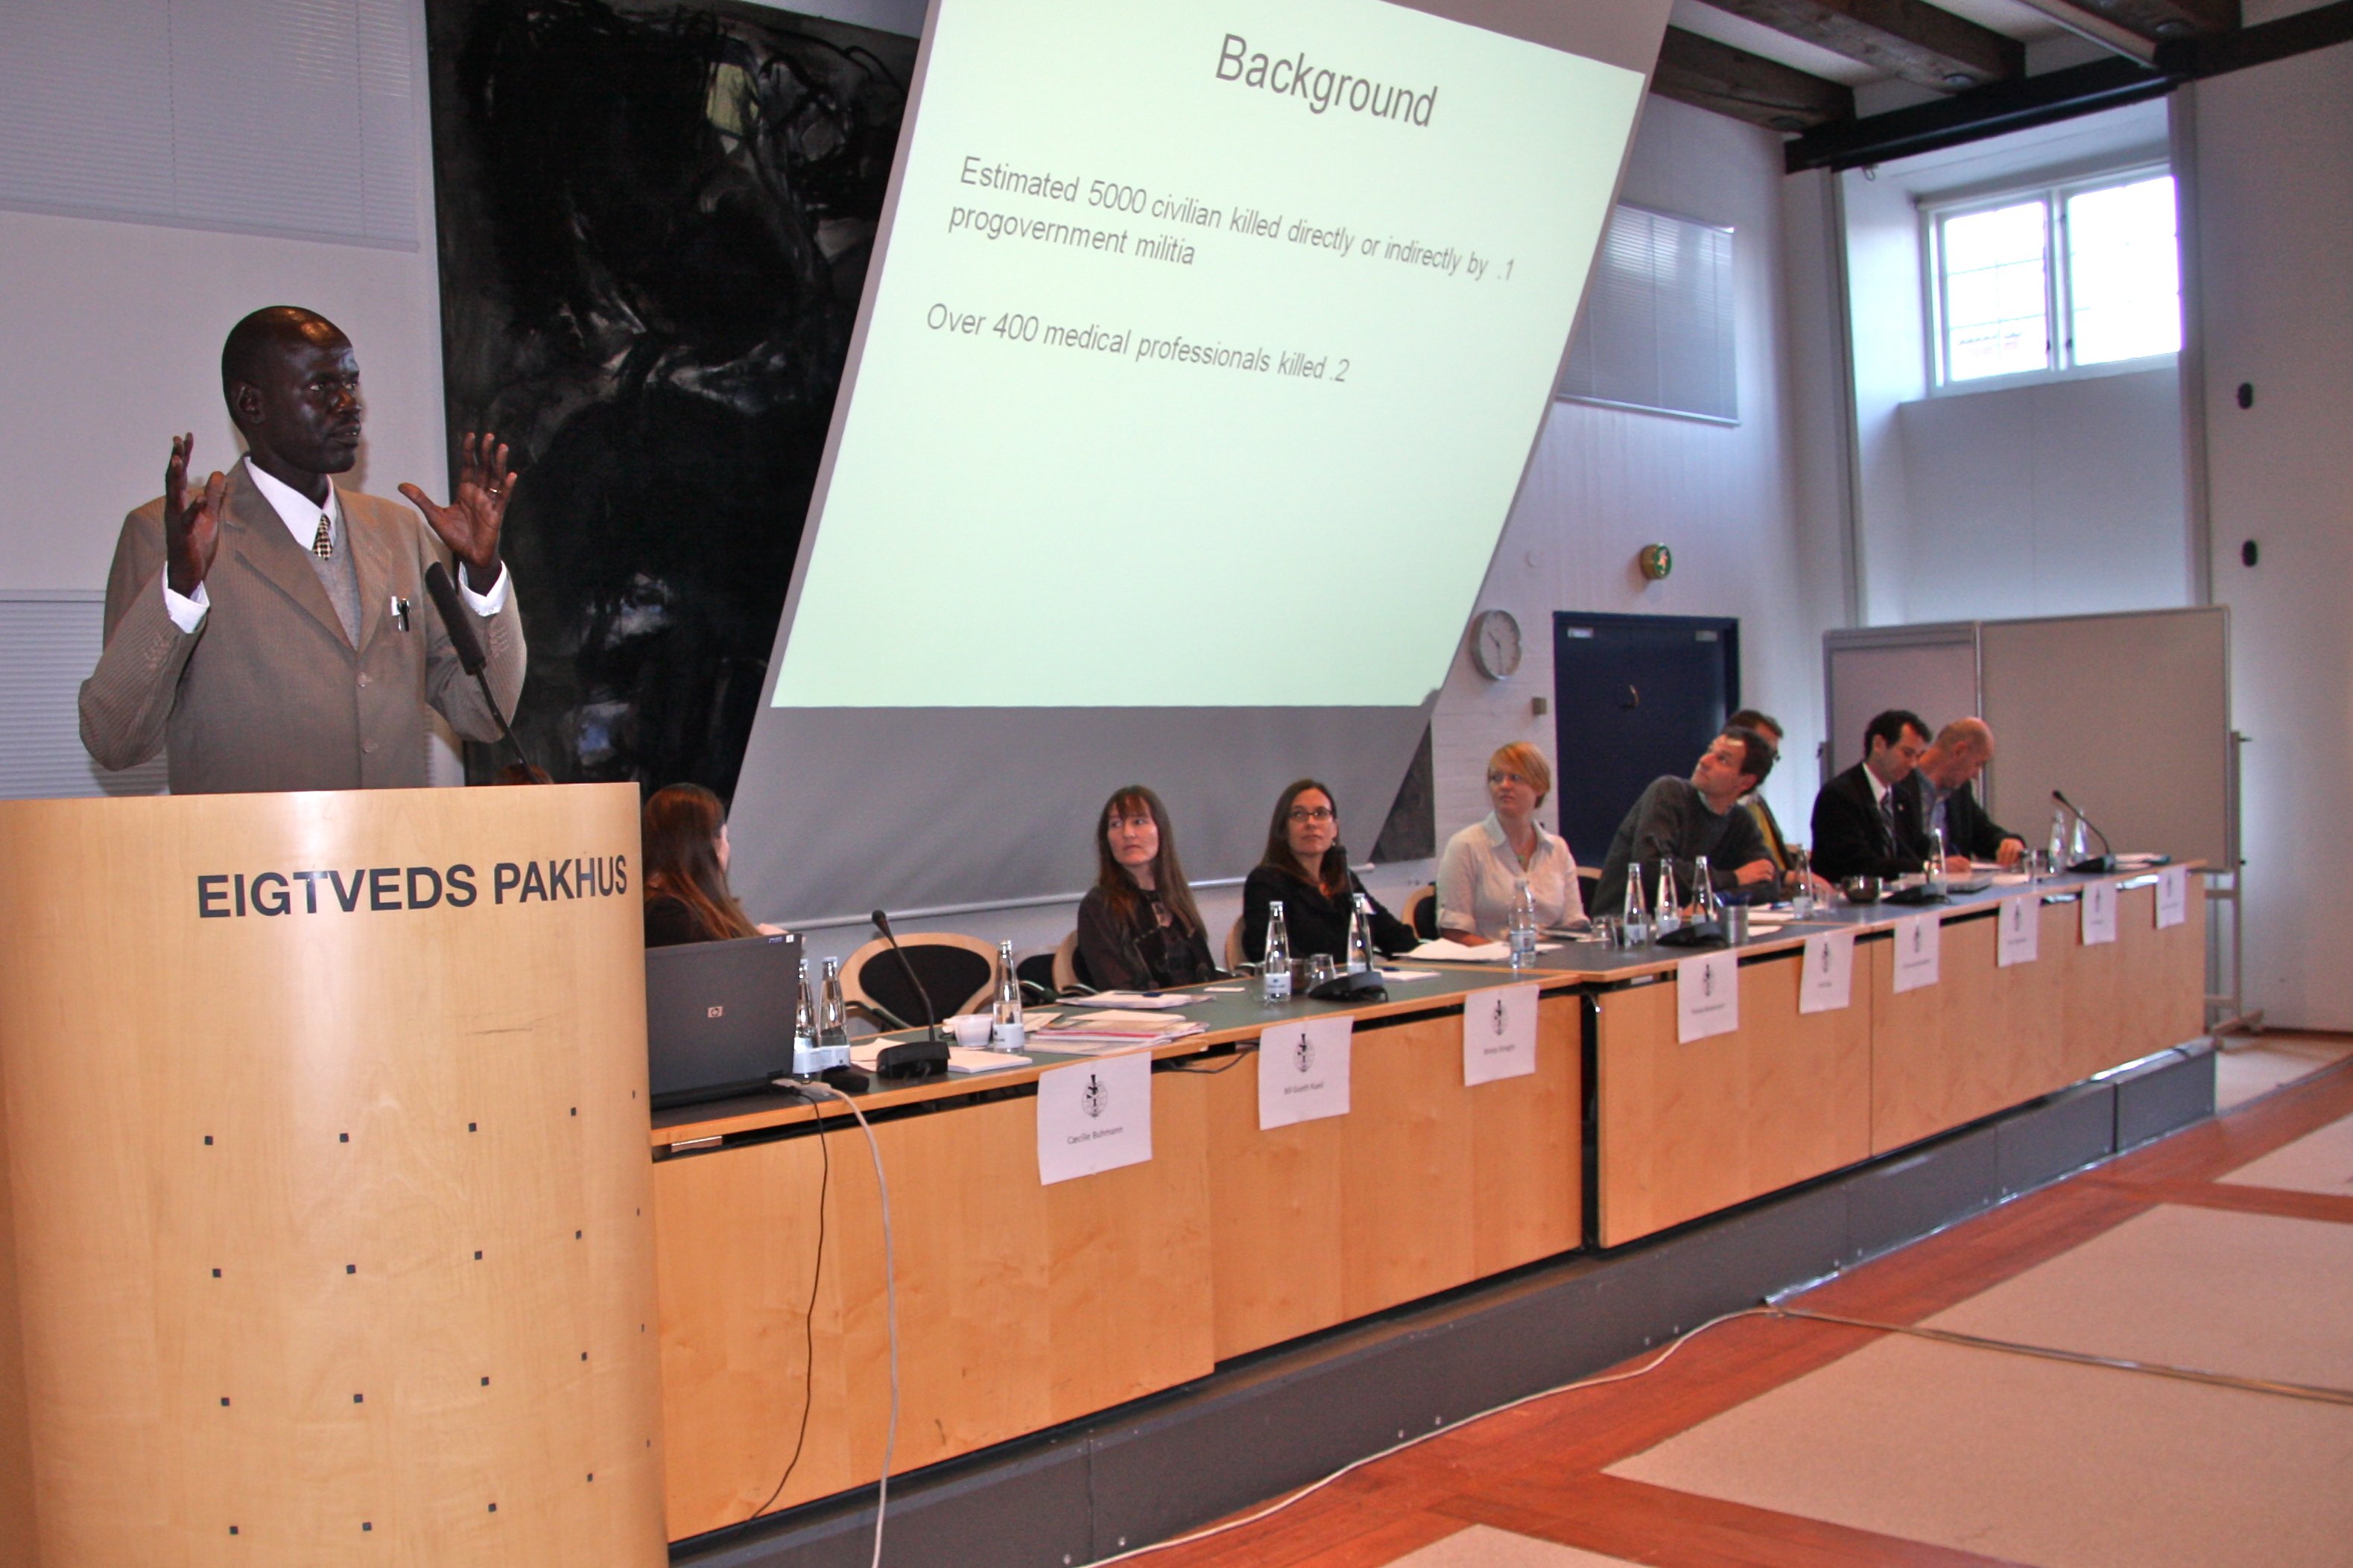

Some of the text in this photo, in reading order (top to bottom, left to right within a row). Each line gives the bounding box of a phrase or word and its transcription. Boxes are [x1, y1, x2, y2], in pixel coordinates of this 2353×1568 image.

[1215, 33, 1439, 127] Background
[948, 206, 1196, 265] progovernment militia
[960, 155, 1080, 203] Estimated
[1088, 180, 1147, 215] 5000
[1151, 197, 1222, 229] civilian
[1229, 206, 1283, 239] killed
[1288, 218, 1355, 258] directly
[1361, 238, 1381, 257] or
[1384, 240, 1462, 276] indirectly
[1466, 251, 1489, 282] by
[927, 302, 987, 335] Over
[992, 312, 1039, 342] 400
[1042, 323, 1132, 355] medical
[1135, 335, 1271, 372] professionals
[1277, 350, 1328, 379] killed
[197, 854, 627, 918] EIGTVEDS PAKHUS
